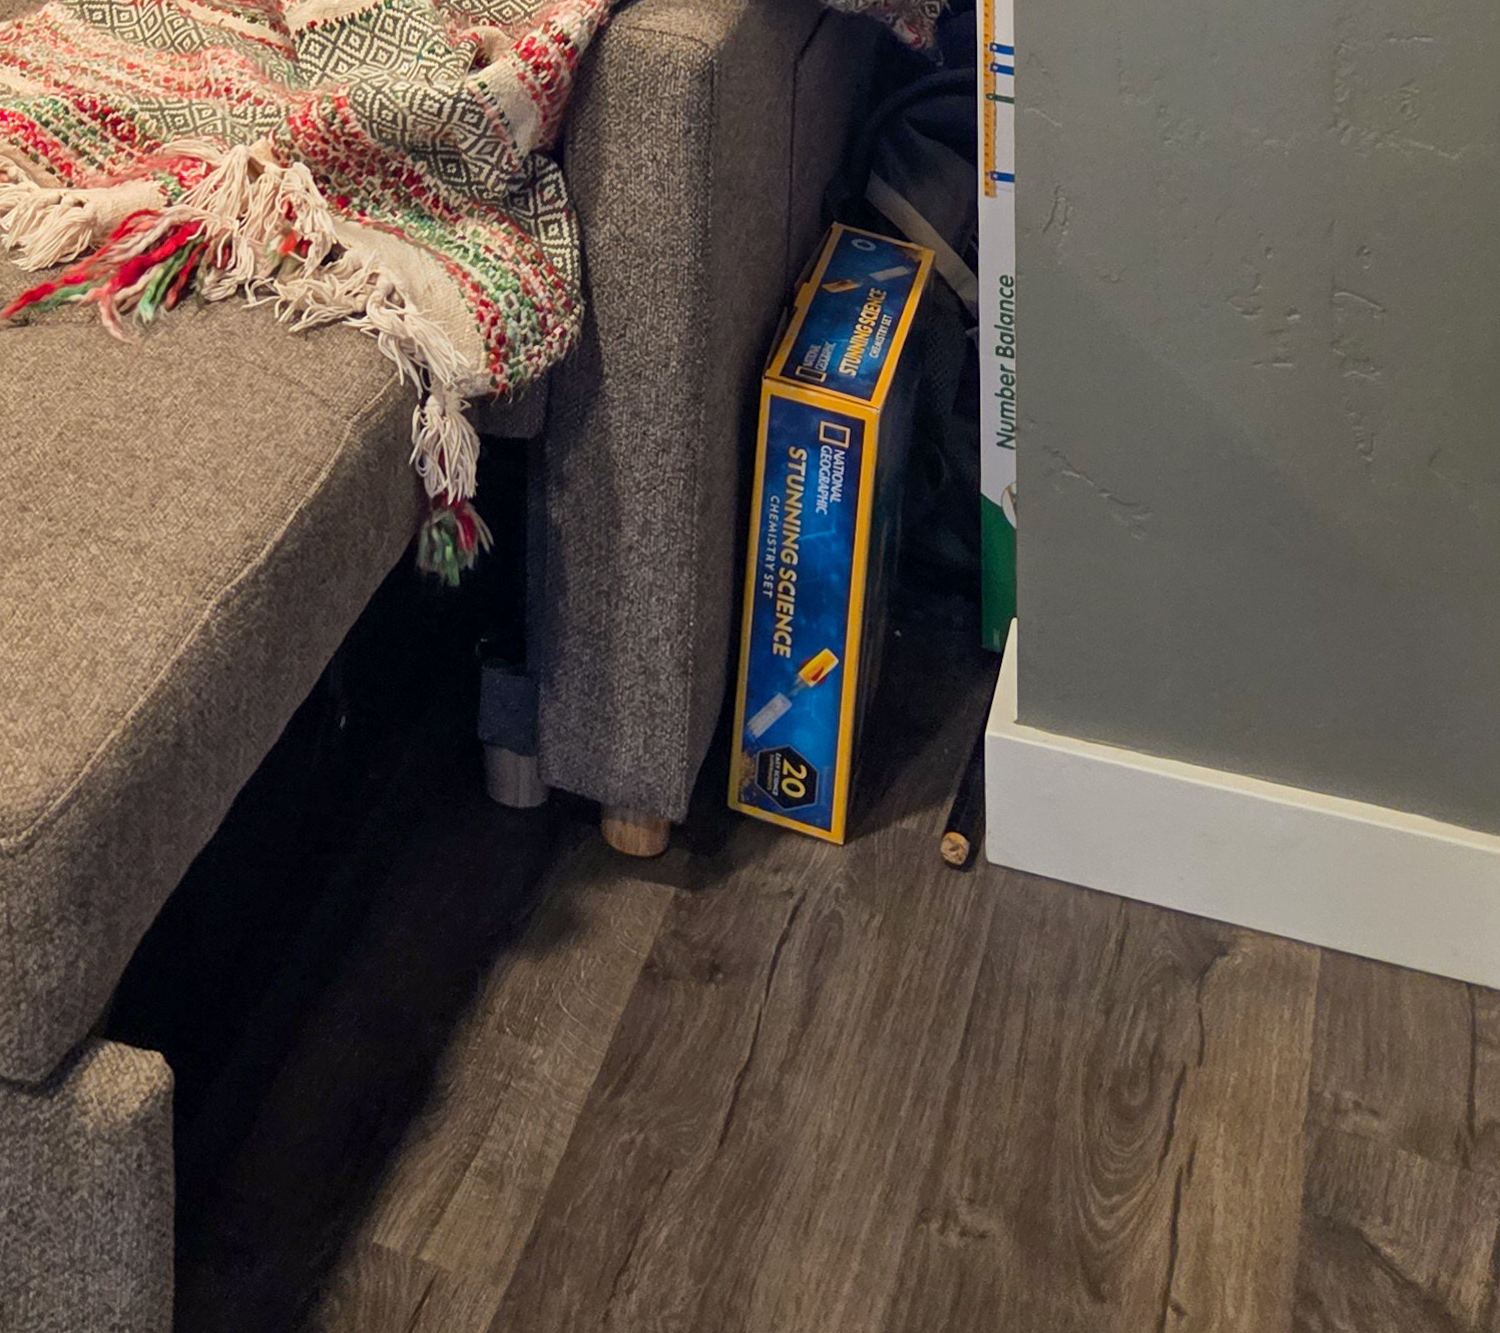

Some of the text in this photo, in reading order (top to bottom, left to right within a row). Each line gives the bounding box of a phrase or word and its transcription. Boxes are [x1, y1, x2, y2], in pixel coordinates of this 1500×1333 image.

[838, 288, 887, 378] STUNNING SCIENCE
[869, 314, 893, 359] CHEMISTRY SET
[994, 274, 1016, 450] Number Balance
[815, 444, 833, 515] GEOGRAPHIC
[829, 448, 846, 504] NATIONAL
[761, 495, 781, 599] CHEMISTRY SET
[772, 445, 808, 659] STUNNING SCIENCE
[774, 752, 782, 769] EASY
[781, 758, 807, 799] 20
